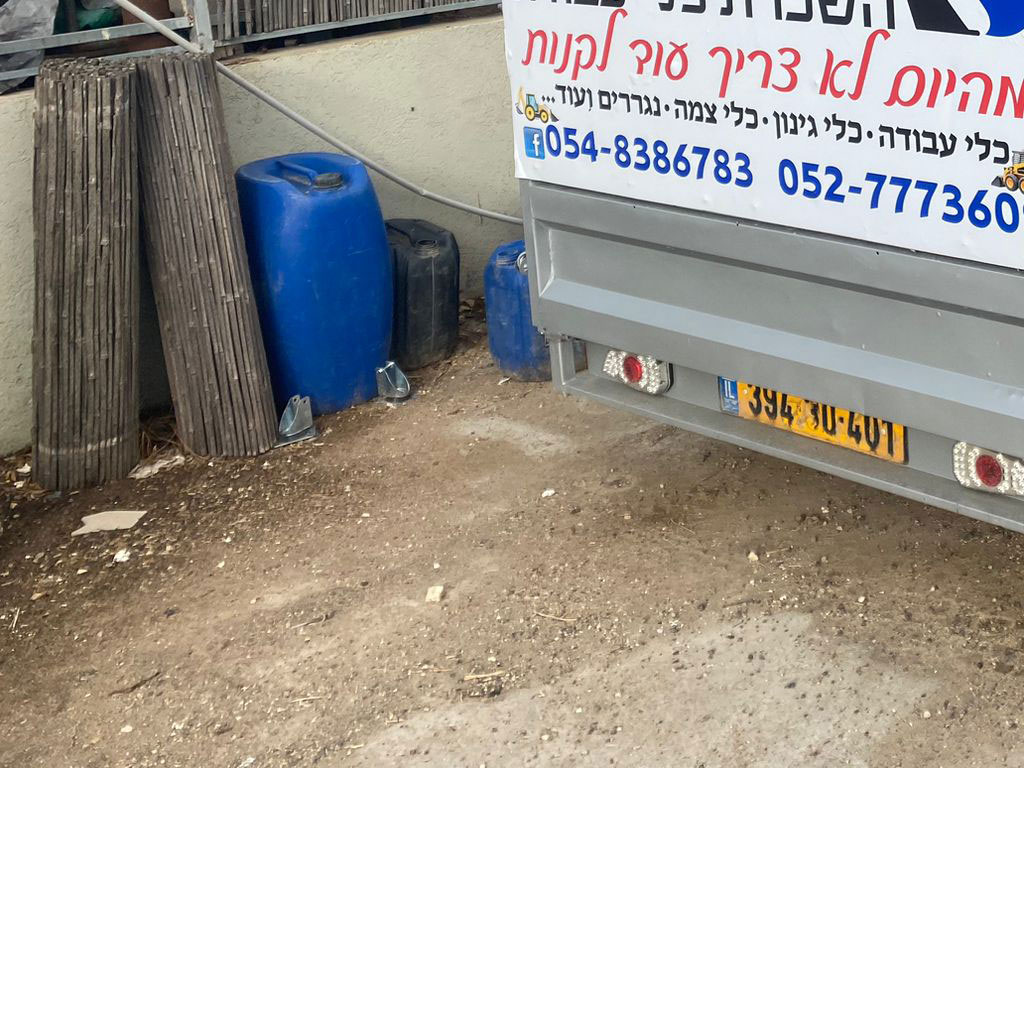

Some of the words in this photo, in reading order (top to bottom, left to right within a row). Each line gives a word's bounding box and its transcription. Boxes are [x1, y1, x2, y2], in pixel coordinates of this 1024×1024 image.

[521, 8, 629, 81] לקנות
[629, 39, 689, 80] עוד
[709, 46, 801, 99] צריך
[819, 28, 892, 101] לא
[597, 89, 661, 116] נגררים
[674, 98, 717, 124] צמה
[723, 100, 758, 129] כלי
[772, 110, 819, 139] גינון
[824, 113, 862, 144] כלי
[879, 124, 957, 157] עבודה
[545, 124, 754, 189] 054-8386783
[965, 131, 1010, 165] כלי
[724, 379, 735, 400] IL
